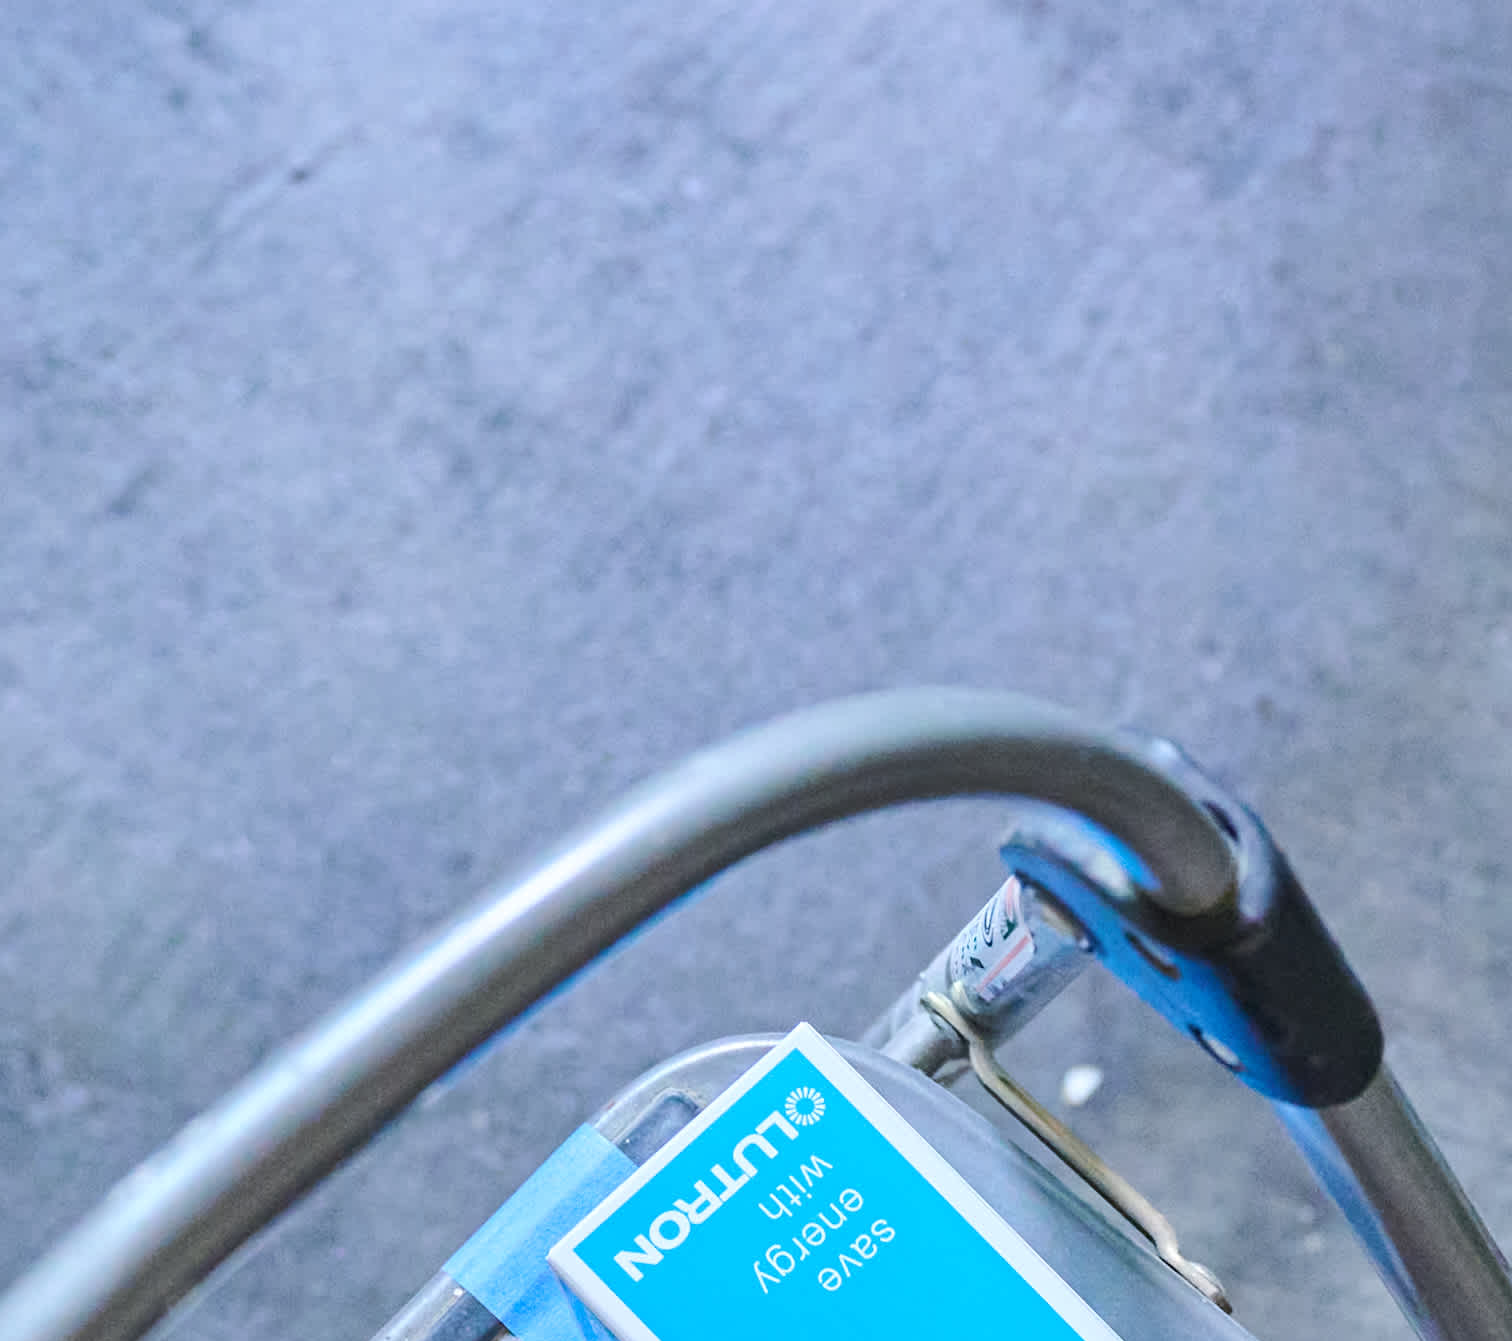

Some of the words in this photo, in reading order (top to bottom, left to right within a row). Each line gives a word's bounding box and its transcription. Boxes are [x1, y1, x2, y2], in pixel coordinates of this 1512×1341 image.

[614, 1110, 799, 1282] LUTRON
[759, 1155, 832, 1219] with
[754, 1189, 863, 1294] energy
[818, 1219, 895, 1291] save
